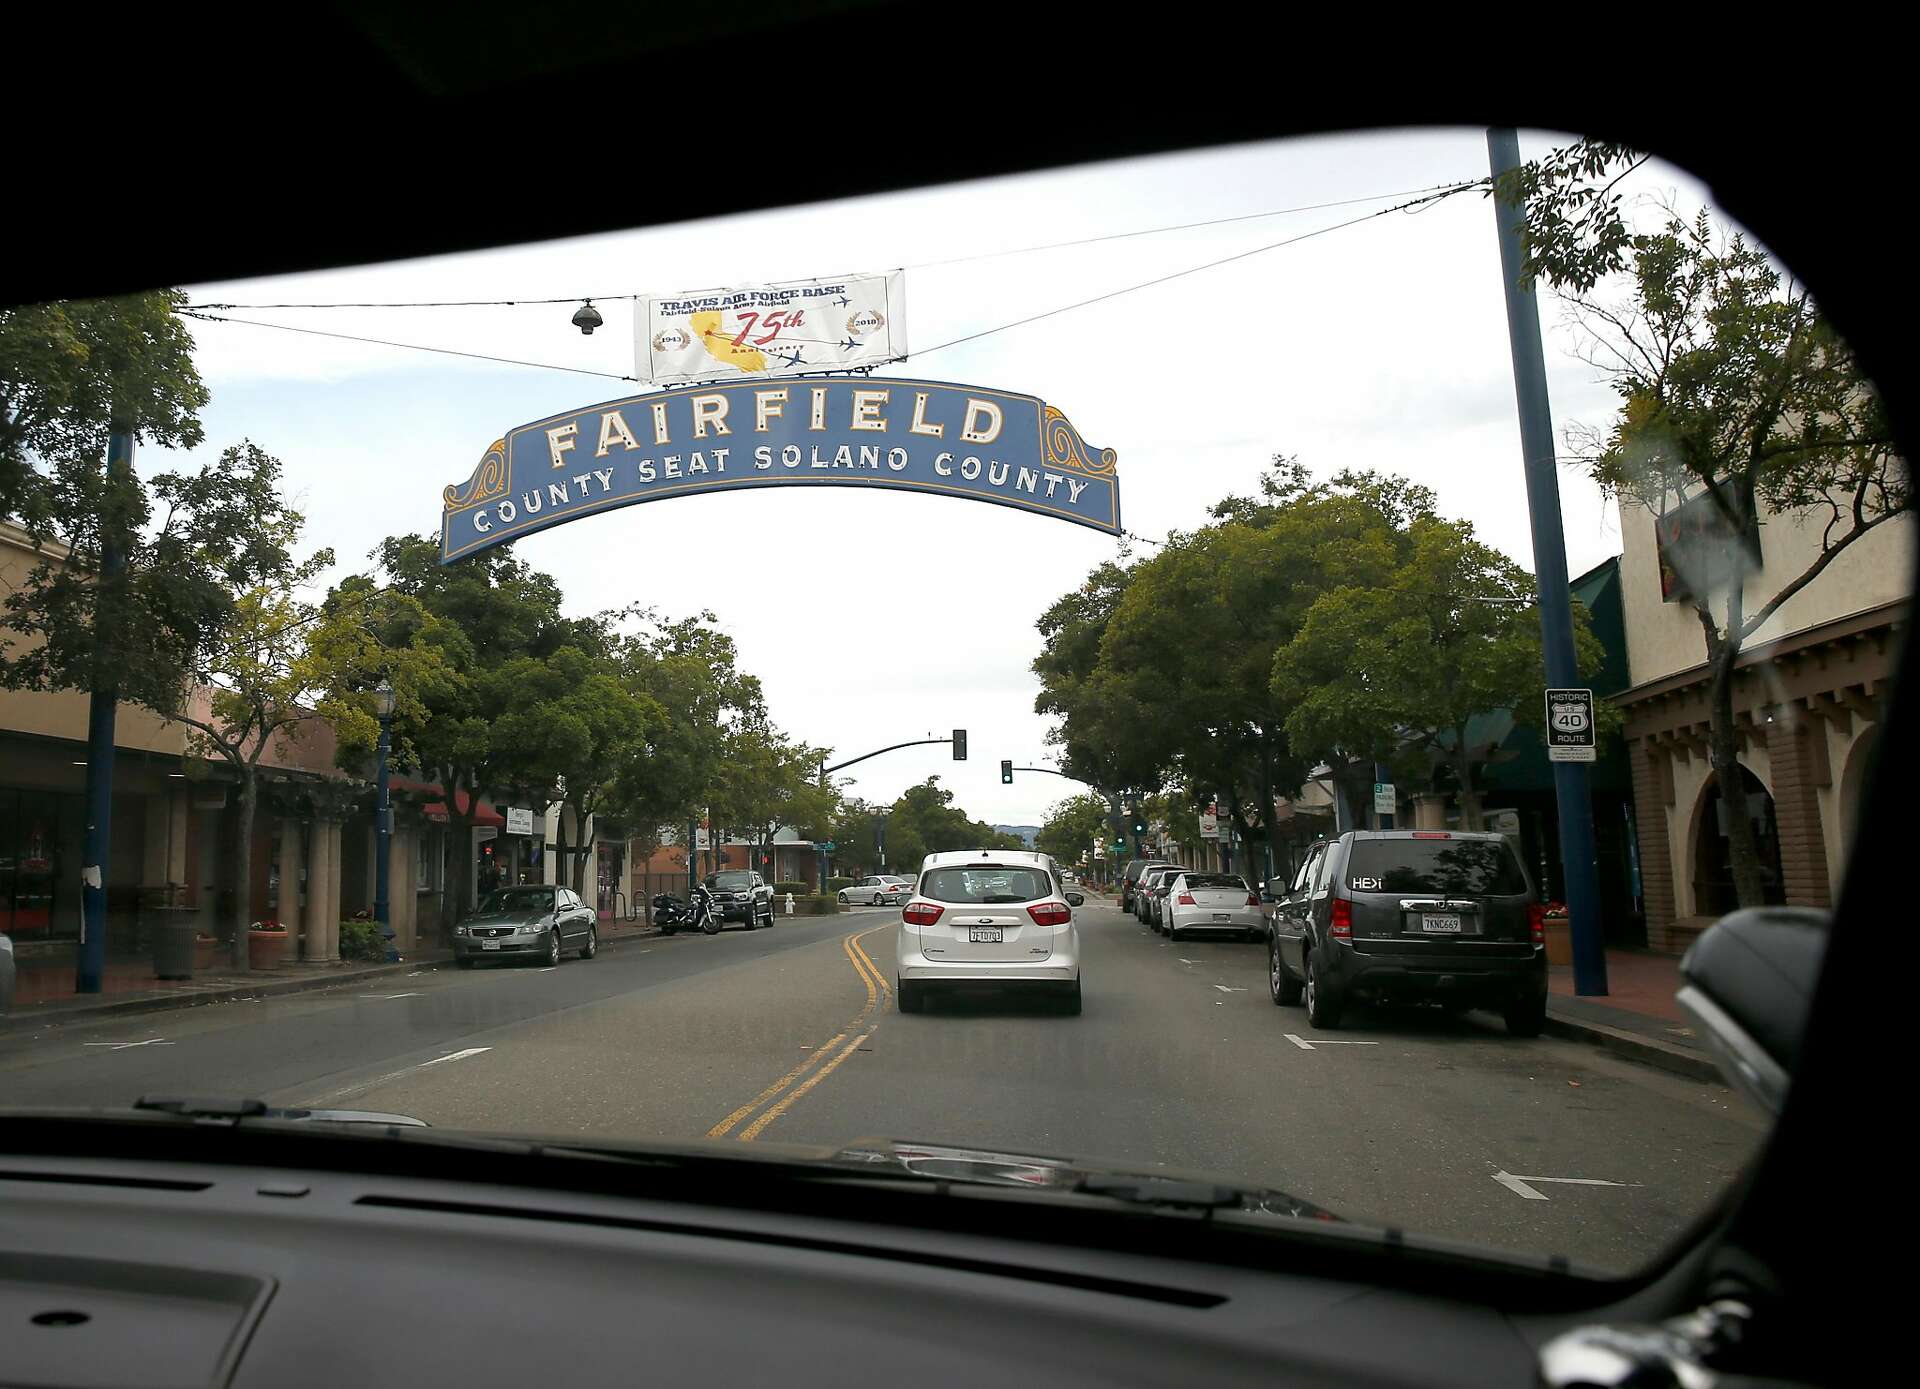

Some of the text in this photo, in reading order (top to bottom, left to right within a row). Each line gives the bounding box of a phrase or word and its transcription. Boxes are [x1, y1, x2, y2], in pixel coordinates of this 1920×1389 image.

[660, 285, 845, 310] TRAVIS AIR FORCE BASE
[733, 300, 754, 309] Army
[757, 299, 790, 307] Airfield
[731, 309, 805, 347] 75th
[545, 387, 1004, 469] FAIRFIELD
[473, 445, 1089, 533] COUNTY SEAT SOLANO COUNTY
[1550, 693, 1589, 701] HISTORIC
[1558, 715, 1582, 727] 40
